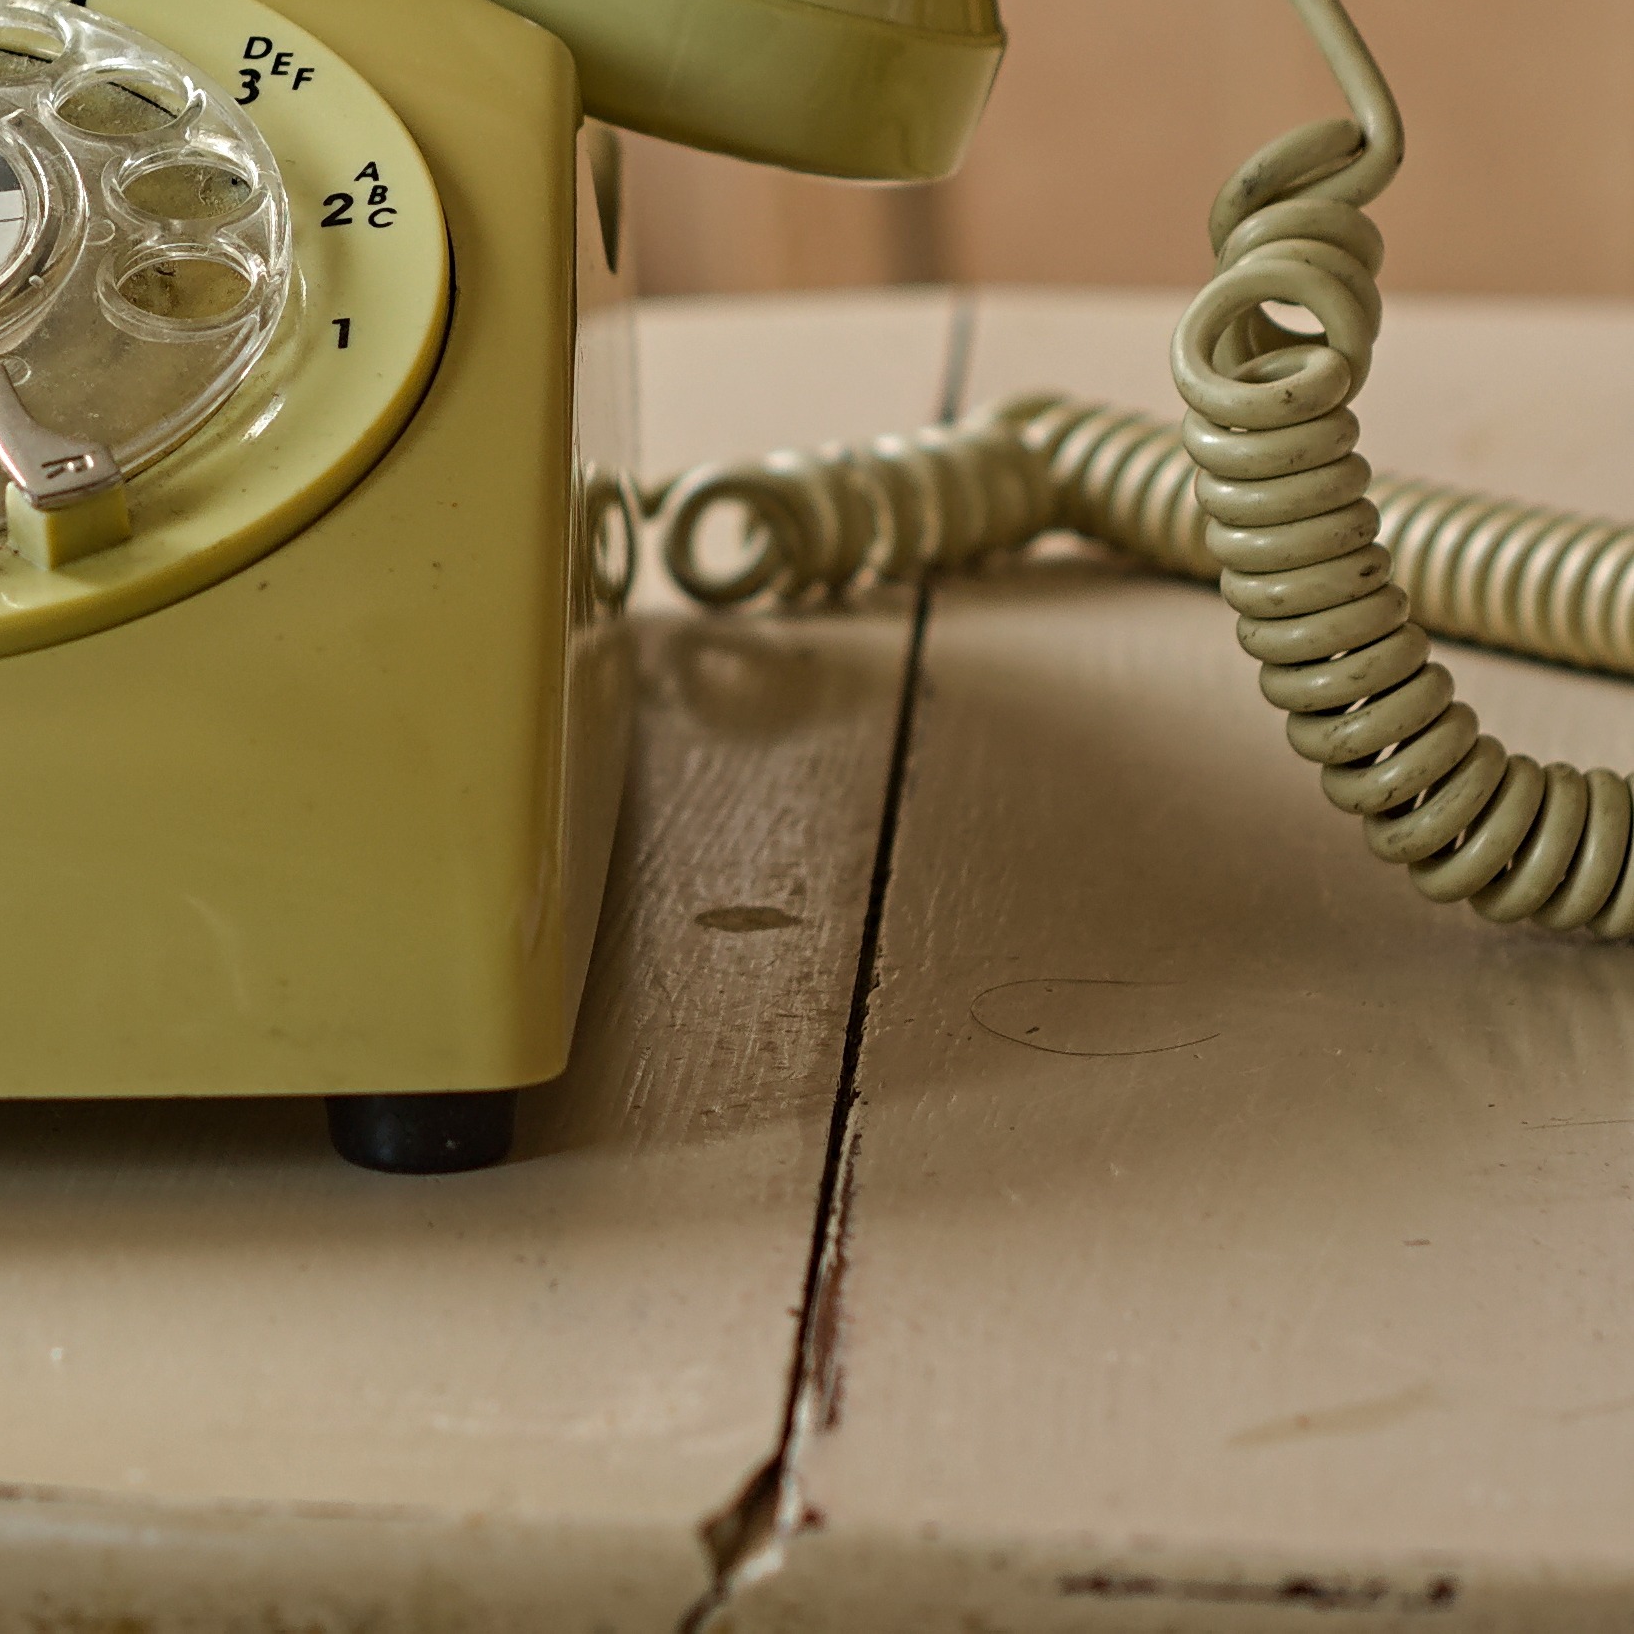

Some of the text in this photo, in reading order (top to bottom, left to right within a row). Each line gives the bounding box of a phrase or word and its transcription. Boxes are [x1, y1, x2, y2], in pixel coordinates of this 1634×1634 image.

[243, 36, 315, 91] DEF
[234, 68, 262, 106] 3
[320, 192, 354, 228] 2
[354, 161, 398, 228] ABC
[331, 317, 351, 350] 1
